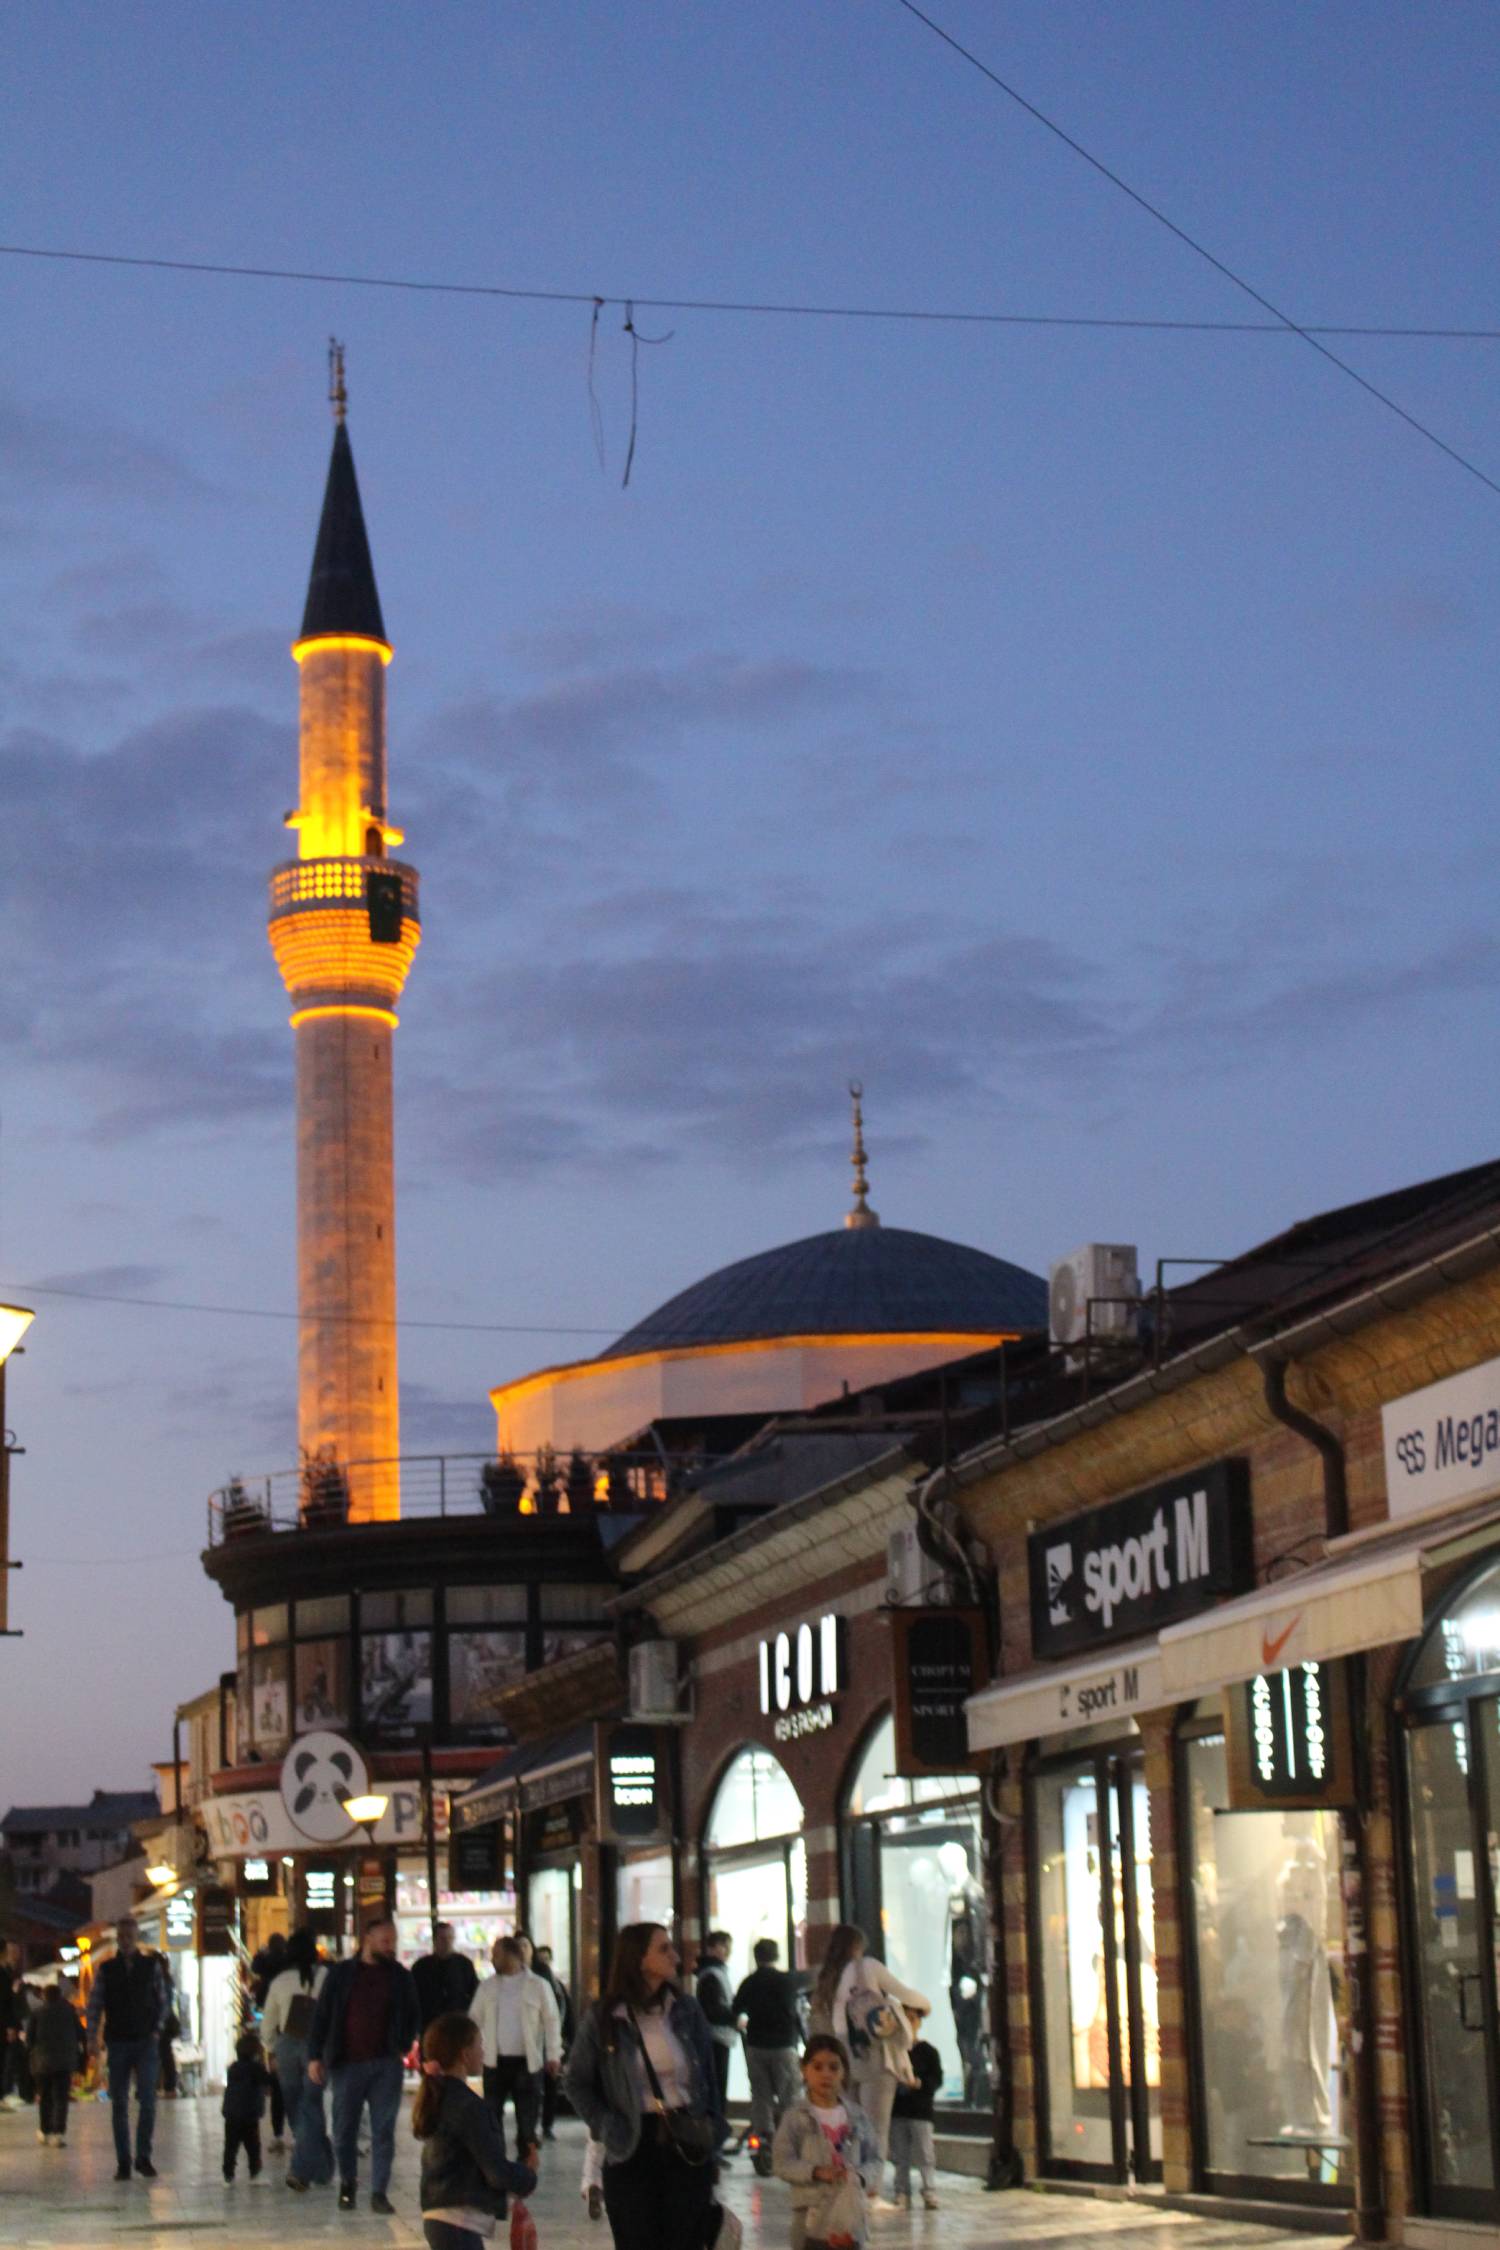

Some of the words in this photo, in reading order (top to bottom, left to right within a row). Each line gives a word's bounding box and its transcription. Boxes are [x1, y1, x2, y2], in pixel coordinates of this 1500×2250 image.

[1434, 1409, 1499, 1471] Mega
[1084, 1507, 1171, 1628] sport
[1174, 1489, 1210, 1584] M
[759, 1613, 838, 1715] ICON
[1078, 1677, 1117, 1720] sport
[1123, 1667, 1138, 1702] M
